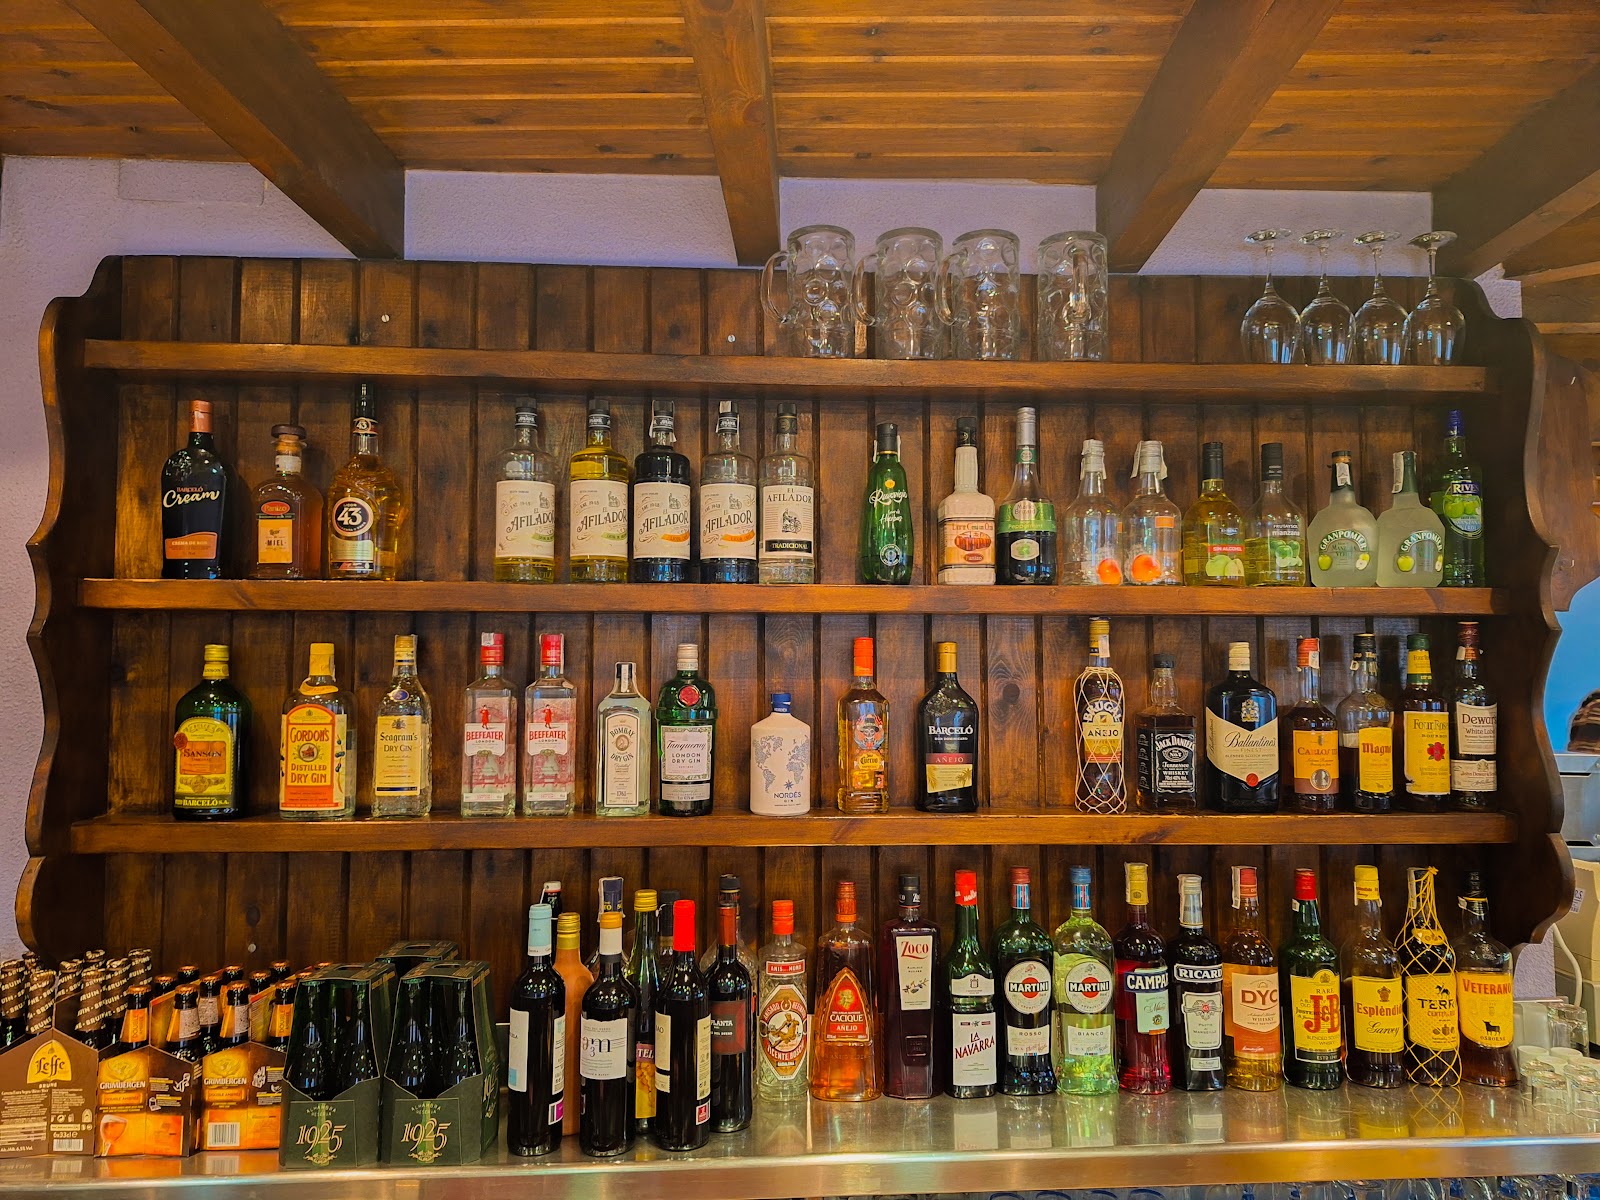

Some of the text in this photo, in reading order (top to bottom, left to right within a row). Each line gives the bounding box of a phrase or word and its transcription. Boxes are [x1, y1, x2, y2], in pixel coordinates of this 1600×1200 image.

[163, 489, 219, 508] Cream
[767, 494, 812, 504] AFILADOR
[336, 507, 363, 526] 43
[704, 510, 753, 536] AFILADOR
[772, 542, 809, 551] TRADICIONAL
[290, 728, 330, 743] GORDON'S
[466, 731, 504, 741] BEEFEATER
[529, 730, 567, 740] BEEFEATER
[609, 727, 636, 738] BOMBAY
[928, 725, 974, 736] BARCELÓ
[1087, 727, 1120, 737] AÑEJO
[380, 732, 418, 744] Seagram's
[667, 739, 706, 751] Tanqueray
[291, 763, 328, 772] DISTILLED
[291, 772, 328, 784] DRY GIN
[1163, 770, 1189, 778] WHISKEY
[183, 798, 218, 807] BARCELÓ
[1009, 982, 1049, 993] MARTINI
[1069, 982, 1109, 993] MARTINI
[1241, 989, 1278, 1006] DYC
[830, 1014, 864, 1023] CACIQUE
[836, 1023, 858, 1032] AÑEJO
[971, 1032, 981, 1043] LA
[955, 1036, 995, 1060] NAVARRA
[34, 1055, 66, 1078] Leffe
[100, 1081, 146, 1091] GRIMBERGEN
[204, 1077, 246, 1087] GRIMBERGEN
[296, 1120, 348, 1155] 1925
[401, 1118, 453, 1152] 1925
